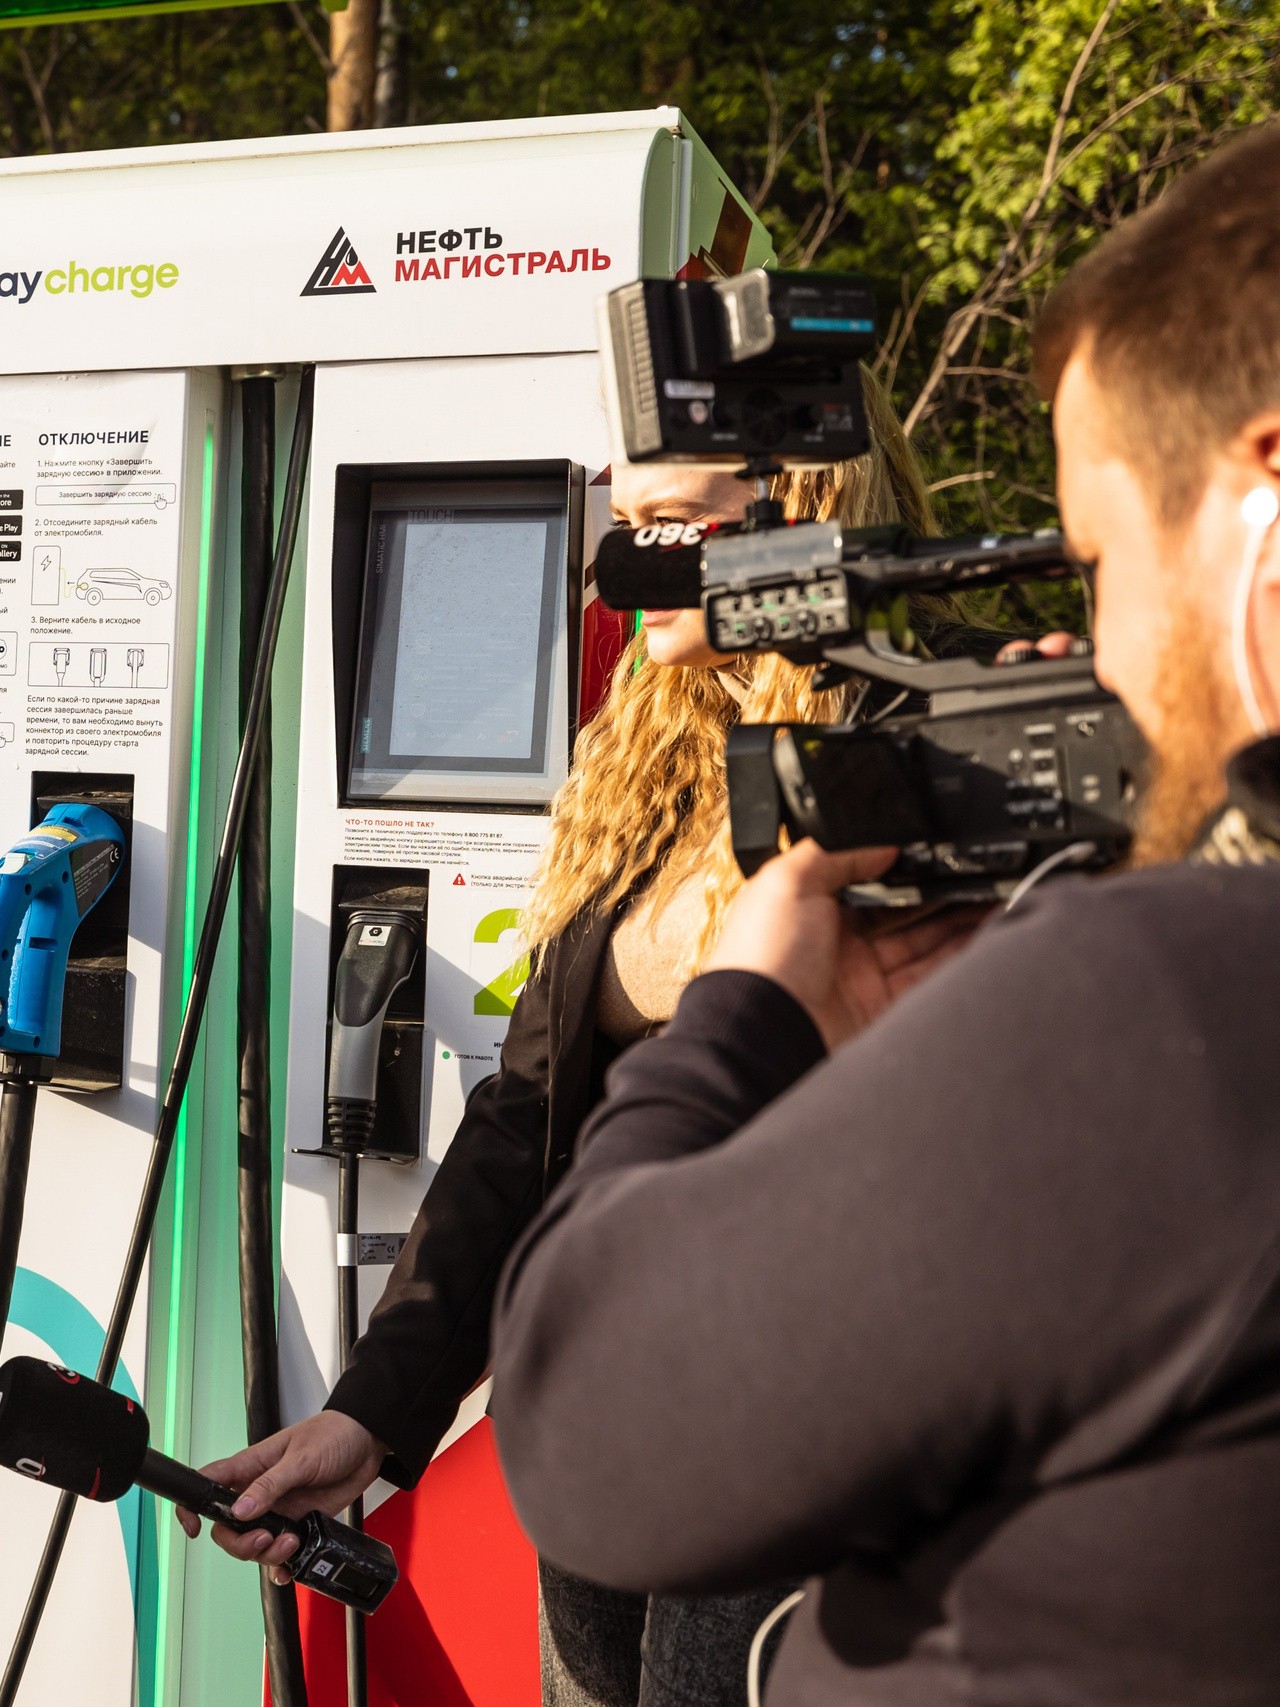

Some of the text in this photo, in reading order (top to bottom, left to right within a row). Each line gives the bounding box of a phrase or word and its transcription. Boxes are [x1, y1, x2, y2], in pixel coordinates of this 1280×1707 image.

[396, 227, 503, 254] НЕФТЬ
[395, 247, 612, 282] МАГИСТРАЛЬ
[39, 430, 149, 446] ОТКЛЮЧЕНИЕ
[106, 456, 152, 467] «Завершить
[37, 471, 71, 479] зарядную
[113, 469, 162, 478] приложении.
[59, 491, 93, 499] Завершить
[94, 489, 126, 499] зарядную
[410, 509, 454, 523] TOUCH
[35, 517, 157, 527] 2. Отсоедините зарядный кабель
[4, 523, 18, 533] Play
[45, 528, 103, 538] электромобиля.
[634, 522, 709, 547] 360
[376, 524, 387, 574] SIMATIC HMI
[31, 615, 37, 623] 3.
[40, 616, 70, 625] Верните
[71, 616, 97, 624] кабель
[105, 617, 141, 625] исходное
[28, 694, 45, 702] Если
[57, 695, 90, 704] какой-то
[92, 697, 123, 705] причине
[54, 707, 103, 715] завершилась
[105, 708, 133, 716] раньше
[27, 717, 60, 725] времени,
[88, 717, 134, 726] необходимо
[136, 719, 163, 728] вынуть
[26, 727, 64, 735] коннектор
[103, 728, 161, 737] электромобиля
[363, 719, 371, 751] SIEMENS
[32, 738, 70, 746] повторить
[72, 739, 112, 748] процедуру
[114, 740, 138, 748] старта
[25, 747, 60, 756] зарядной
[346, 818, 374, 826] ЧТО-ТО
[375, 819, 403, 827] ПОШЛО
[474, 908, 531, 1016] 2
[317, 1564, 328, 1574] 22
